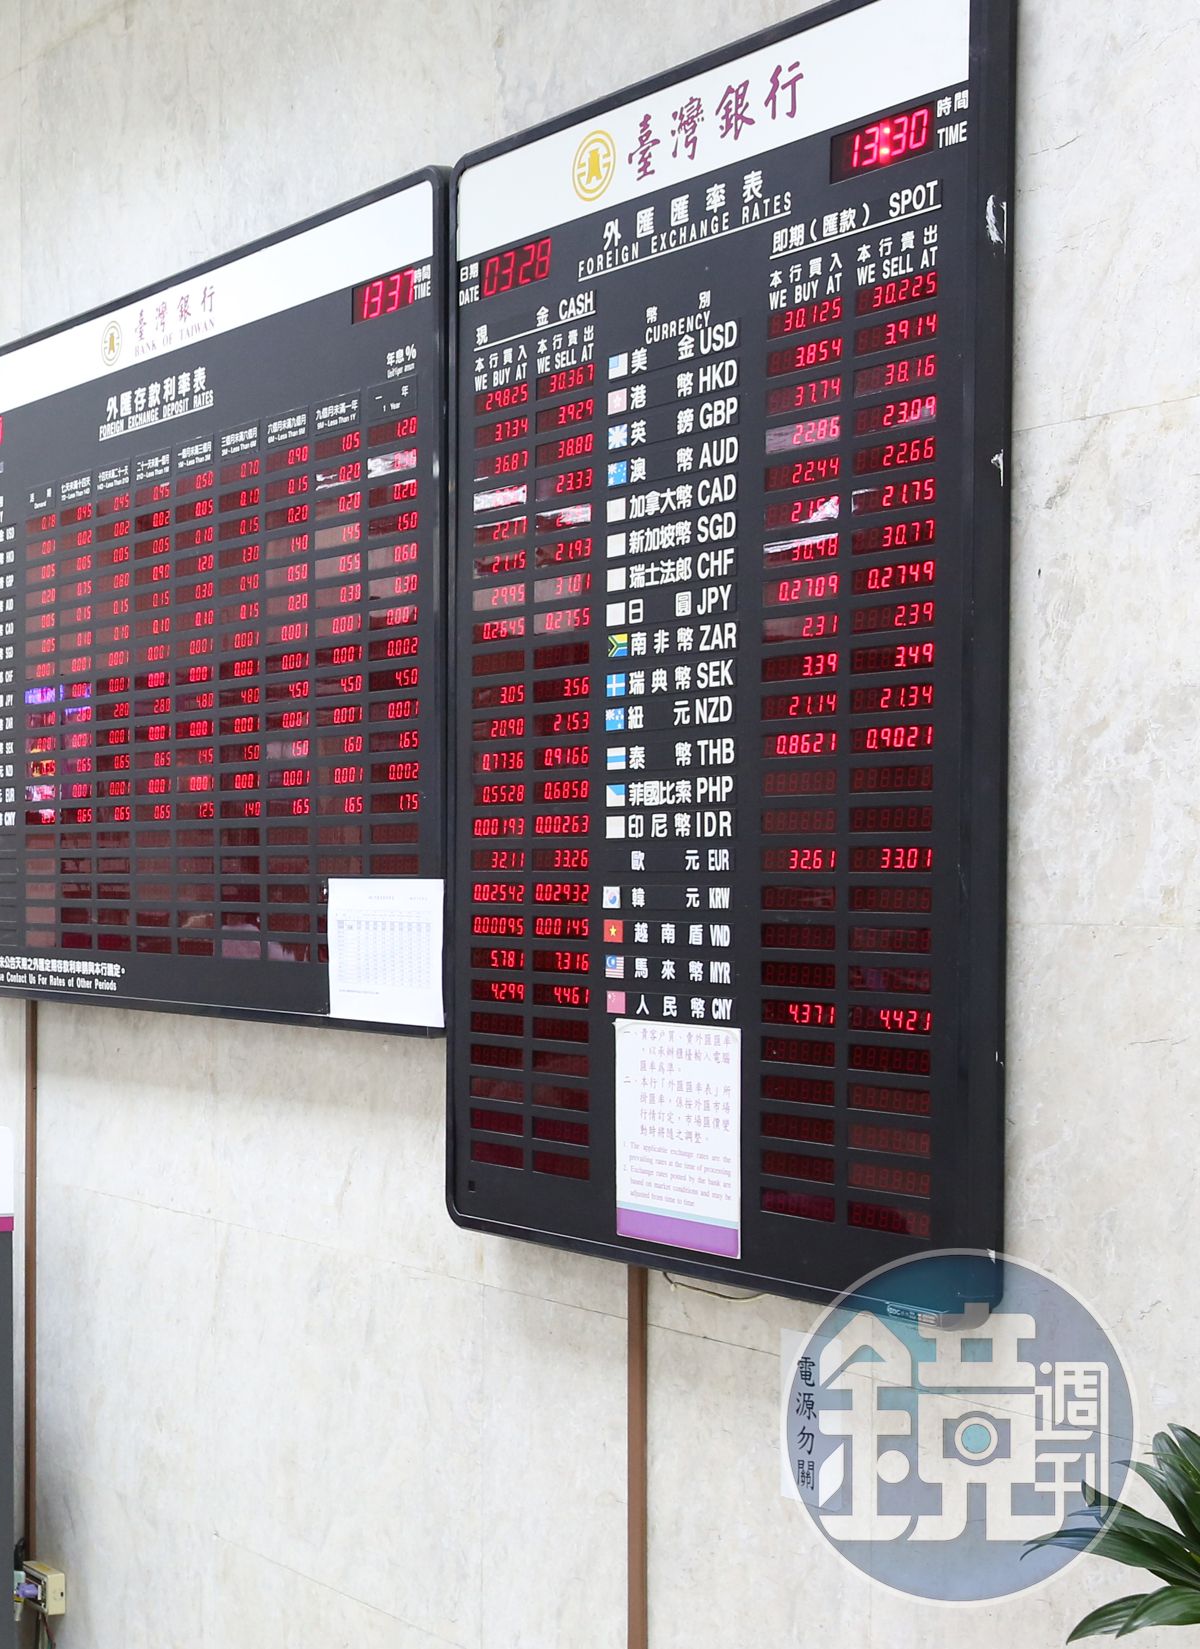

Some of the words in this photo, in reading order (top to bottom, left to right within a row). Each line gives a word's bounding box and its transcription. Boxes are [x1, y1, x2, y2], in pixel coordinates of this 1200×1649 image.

[935, 90, 970, 118] 時間
[627, 59, 805, 183] 臺灣銀行
[936, 121, 968, 150] TIME
[849, 108, 931, 169] 13:30
[602, 169, 764, 249] 外匯匯率表
[889, 180, 938, 218] SPOT
[577, 241, 641, 278] FOREIGN
[649, 215, 734, 256] EXCHANGE
[741, 190, 792, 225] RATES
[857, 224, 938, 262] 本行賣出
[414, 264, 431, 284] 時間
[460, 262, 479, 283] 日期
[770, 253, 843, 288] 本行買入
[857, 264, 875, 286] WE
[882, 253, 913, 280] SELL
[920, 246, 938, 269] AT
[414, 281, 431, 300] TIME
[459, 285, 480, 306] DATE
[559, 290, 594, 320] CASH
[769, 289, 787, 310] WE
[795, 277, 818, 302] BUY
[826, 272, 843, 295] AT
[135, 339, 156, 357] BANK
[163, 334, 172, 346] OF
[180, 319, 215, 341] TAIWAN
[537, 324, 595, 354] 本行賣出
[645, 310, 710, 345] CURRENCY
[700, 321, 738, 354] USD
[474, 344, 528, 372] 本行買入
[536, 356, 551, 375] WE
[554, 348, 577, 370] SELL
[581, 343, 595, 362] AT
[474, 375, 488, 392] WE
[492, 368, 511, 387] BUY
[515, 363, 527, 381] AT
[699, 359, 738, 394] HKD
[106, 366, 206, 422] 外匯存款利率表
[99, 419, 124, 440] FOREIGN
[128, 408, 159, 428] EXCHANGE
[163, 397, 189, 419] DEPOSIT
[193, 390, 214, 409] RATES
[699, 397, 738, 431] GBP
[699, 436, 739, 470] AUD
[629, 483, 693, 520] 加拿大幣
[698, 473, 737, 507] CAD
[628, 519, 692, 555] 新加坡幣
[697, 511, 736, 543] SGD
[629, 555, 693, 590] 瑞士法郎
[697, 549, 735, 579] CHF
[697, 584, 733, 615] JPY
[630, 626, 694, 657] 南非幣
[699, 622, 737, 651] ZAR
[628, 665, 692, 696] 瑞典幣
[696, 659, 734, 689] SEK
[695, 695, 733, 725] NZD
[697, 737, 735, 766] THB
[628, 780, 692, 807] 菲國比索
[696, 776, 734, 803] PHP
[628, 812, 691, 839] 印尼幣
[696, 811, 732, 838] IDR
[707, 849, 730, 872] EUR
[708, 887, 730, 909] KRW
[634, 922, 704, 947] 越南盾
[709, 924, 731, 948] VND
[7, 972, 27, 984] Contact
[29, 974, 36, 984] Us
[38, 975, 47, 985] For
[50, 975, 65, 987] Rates
[68, 977, 74, 988] of
[76, 978, 92, 989] Other
[95, 979, 117, 991] Periods
[634, 957, 704, 982] 馬來幣
[709, 961, 731, 984] MYR
[636, 994, 706, 1019] 人民幣
[712, 997, 733, 1020] CNY
[795, 1356, 817, 1491] 電源勿關
